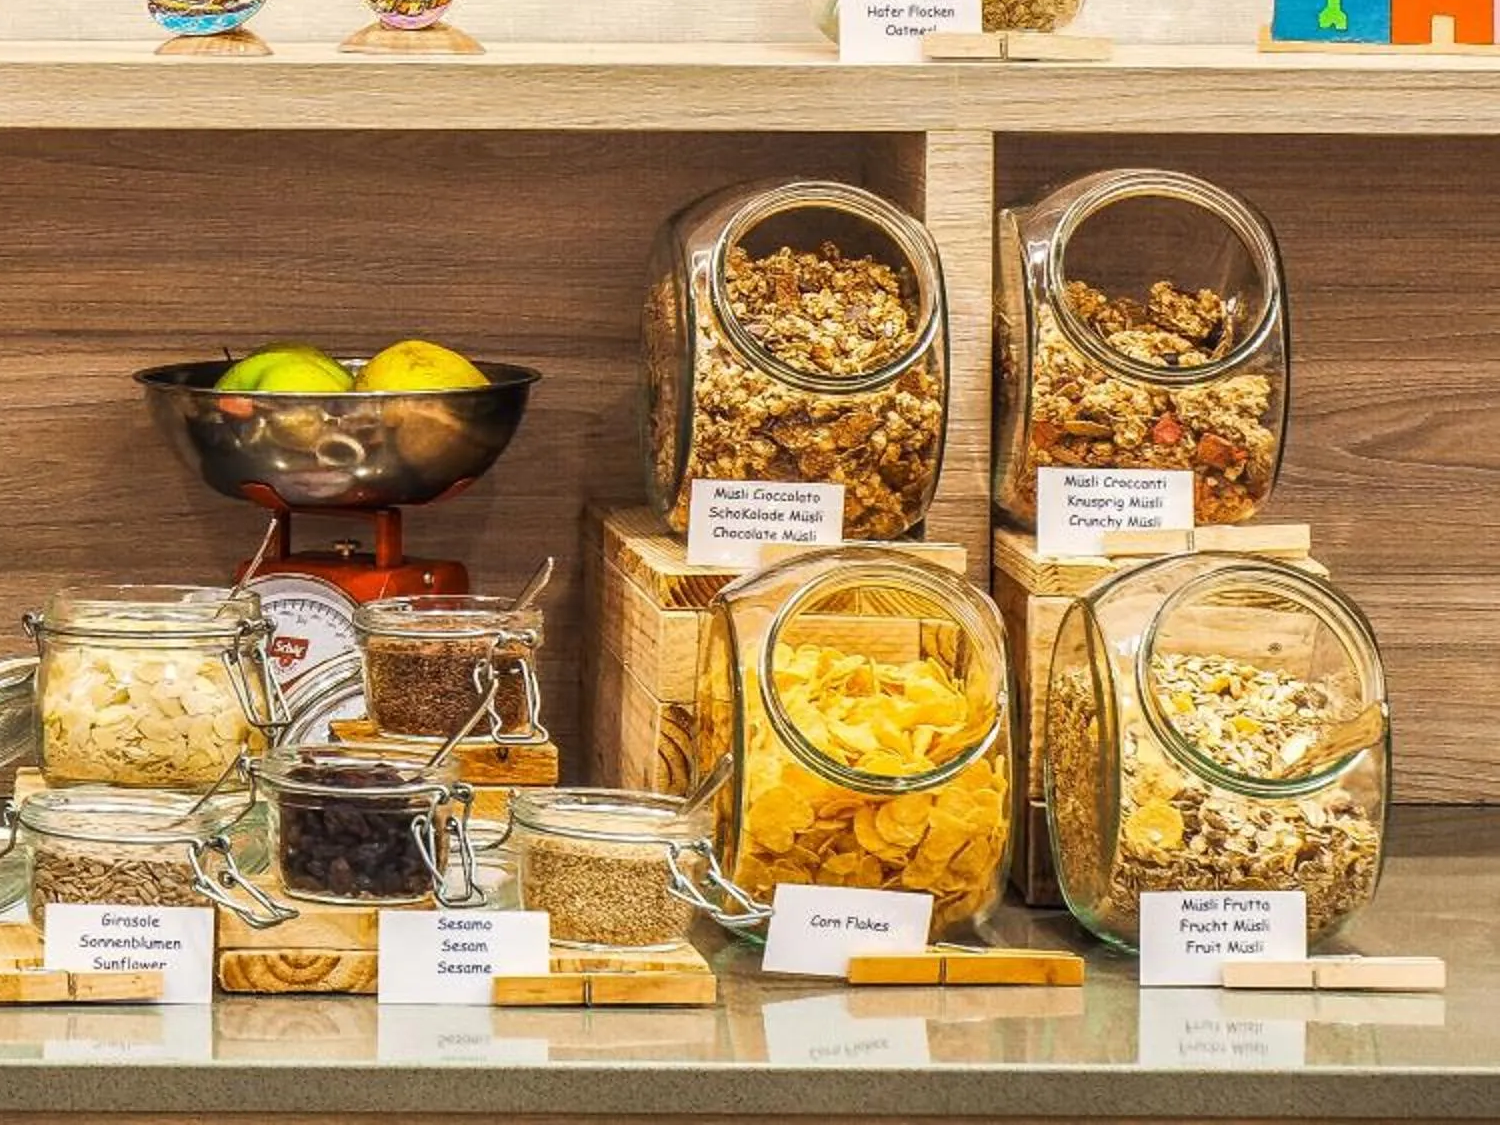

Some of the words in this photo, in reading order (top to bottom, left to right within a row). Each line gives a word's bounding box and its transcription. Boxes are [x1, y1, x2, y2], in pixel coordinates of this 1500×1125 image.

[867, 5, 906, 18] Hafer
[908, 5, 955, 18] Flocken
[1064, 475, 1099, 488] Müsli
[1103, 476, 1167, 490] Croccanti
[714, 487, 749, 500] Müsli
[753, 488, 821, 503] Cioccolato
[1067, 495, 1124, 511] Knusprig
[1129, 496, 1163, 509] Müsli
[788, 510, 823, 523] Müsli
[1069, 514, 1123, 528] Crunchy
[1128, 516, 1162, 528] Müsli
[713, 526, 777, 540] Chocolate
[781, 529, 817, 542] Müsli
[1181, 898, 1219, 912] Müsli
[101, 912, 161, 928] Girasole
[437, 916, 493, 931] Sesamo
[810, 914, 841, 928] Corn
[845, 916, 890, 932] Flakes
[1179, 918, 1228, 932] Frucht
[1233, 919, 1271, 932] Müsli
[79, 934, 182, 950] Sonnenblumen
[441, 938, 488, 952] Sesam
[1185, 940, 1221, 954] Fruit
[1227, 941, 1265, 954] Müsli
[93, 956, 168, 970] Sunflower
[437, 960, 492, 974] Sesame
